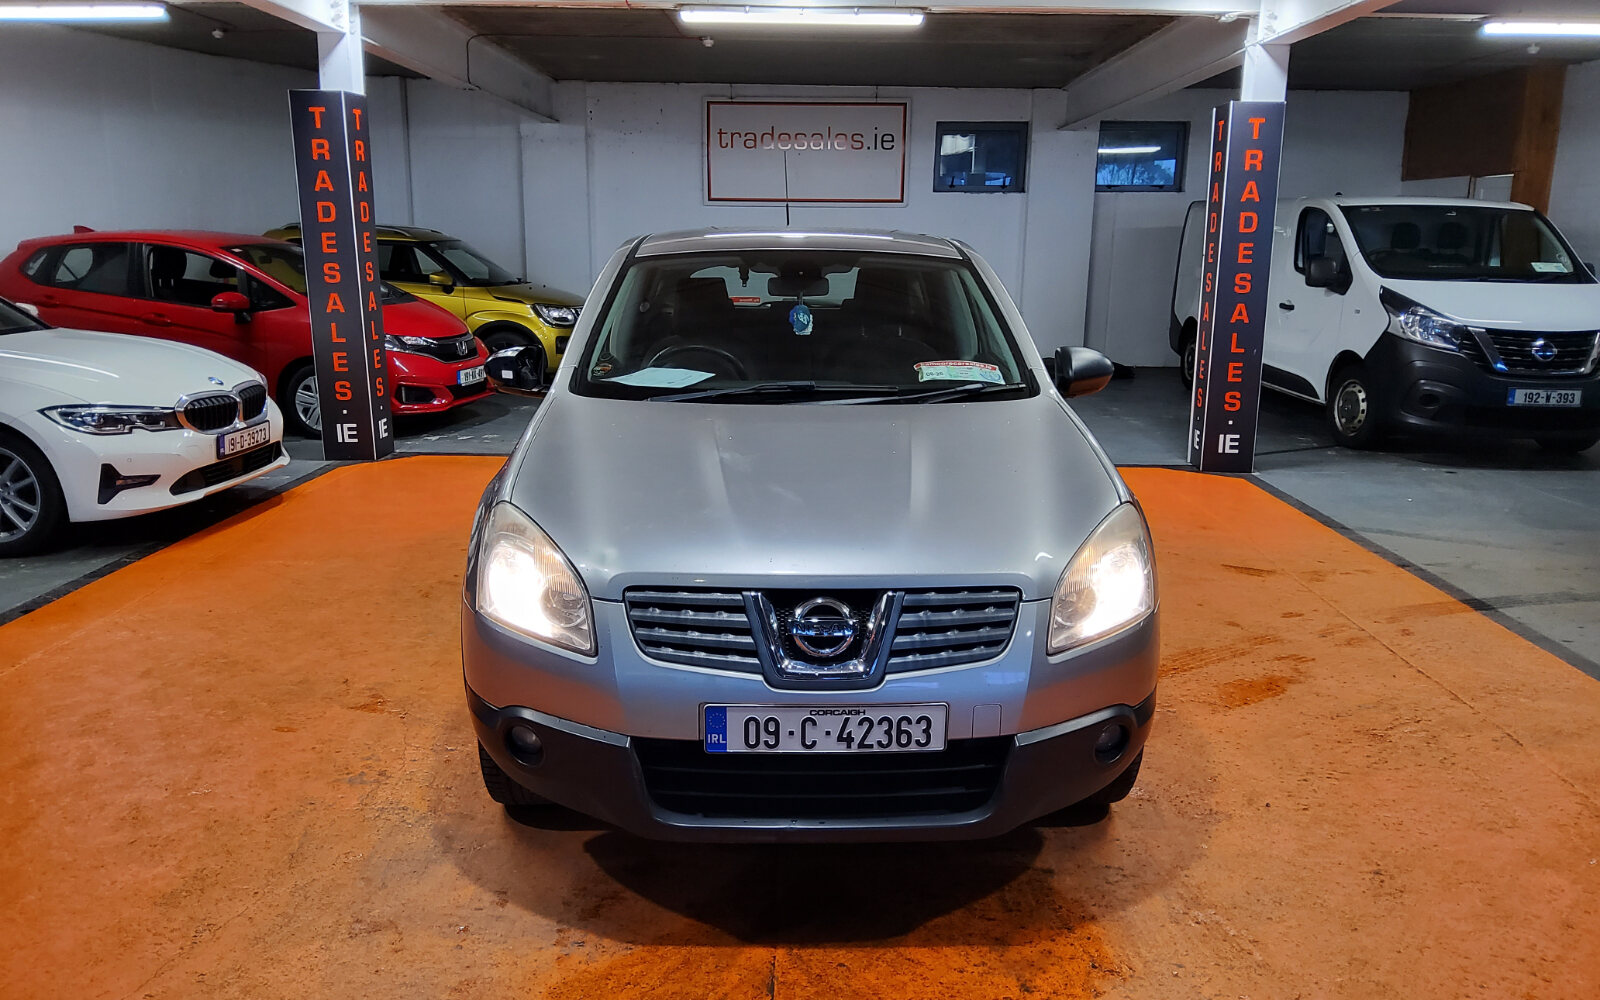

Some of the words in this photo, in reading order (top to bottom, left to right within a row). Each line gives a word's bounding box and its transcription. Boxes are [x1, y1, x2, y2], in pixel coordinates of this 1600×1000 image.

[717, 125, 895, 151] tradesales.ie
[1523, 392, 1576, 404] 192-W-393
[228, 427, 267, 453] 191-D-39273
[809, 708, 866, 716] CORCAIGH
[707, 733, 727, 744] IRL
